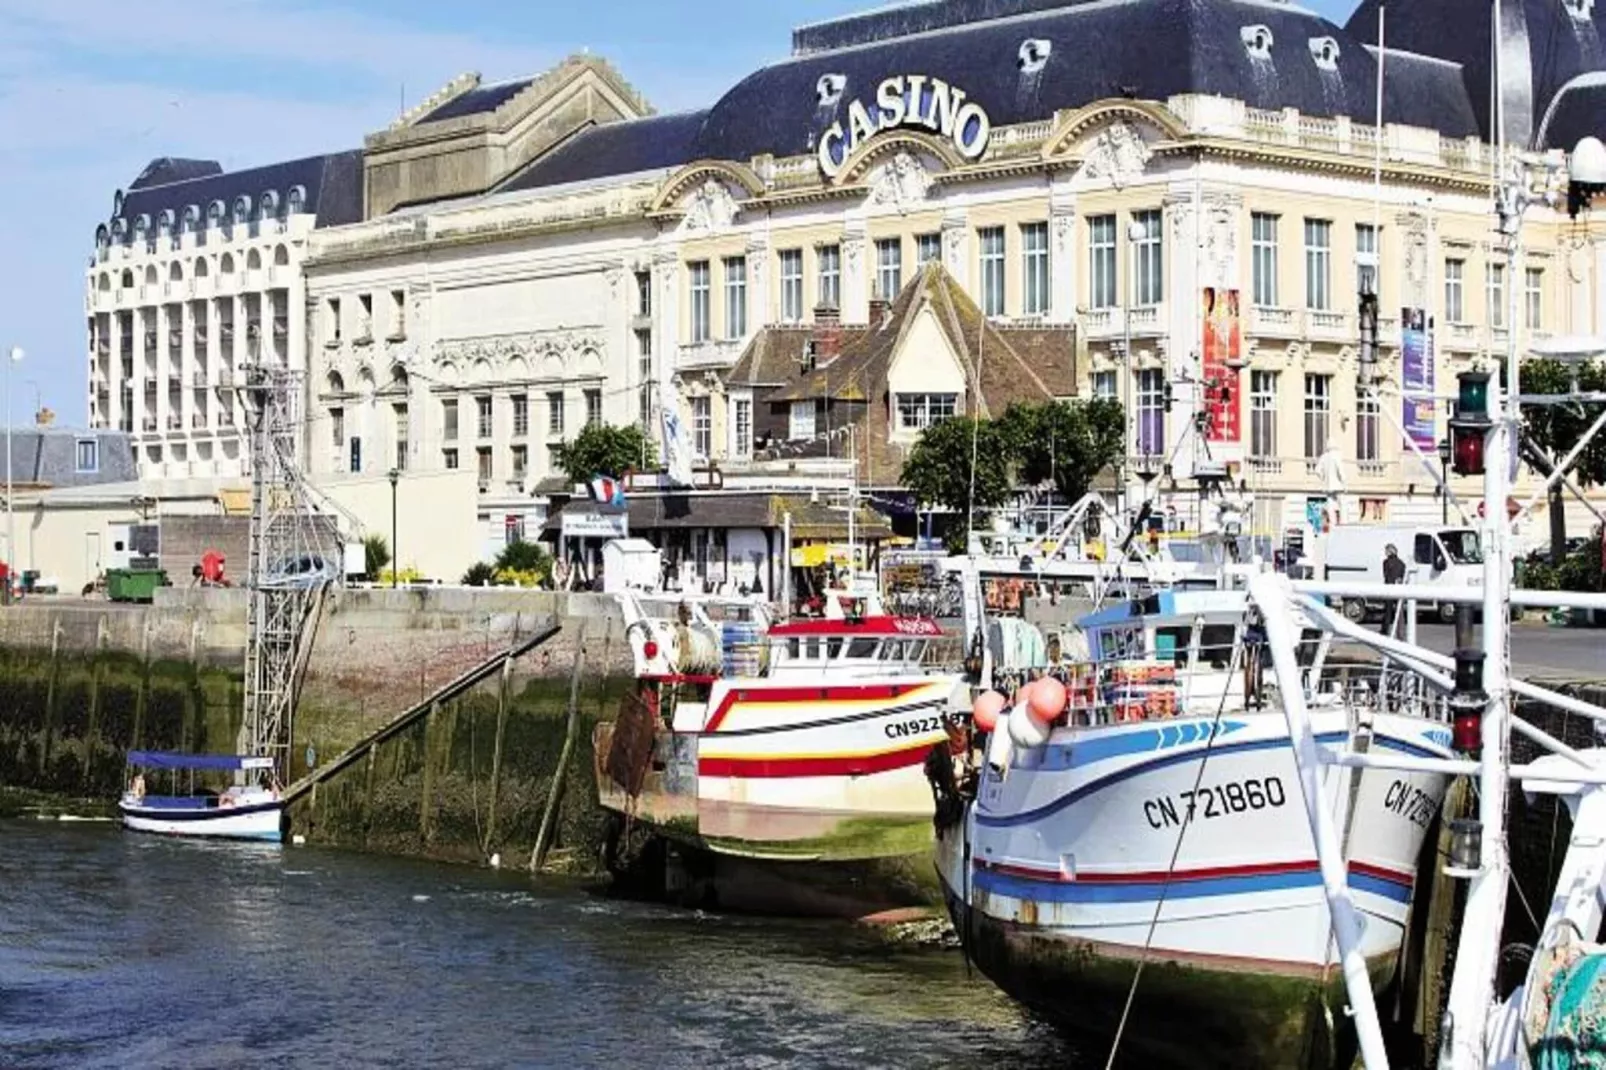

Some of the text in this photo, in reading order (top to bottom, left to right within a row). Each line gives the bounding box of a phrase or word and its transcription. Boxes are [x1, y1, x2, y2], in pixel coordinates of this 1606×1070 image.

[818, 75, 990, 177] CASINO
[1143, 776, 1286, 829] CN 721860
[1385, 780, 1412, 814] CN
